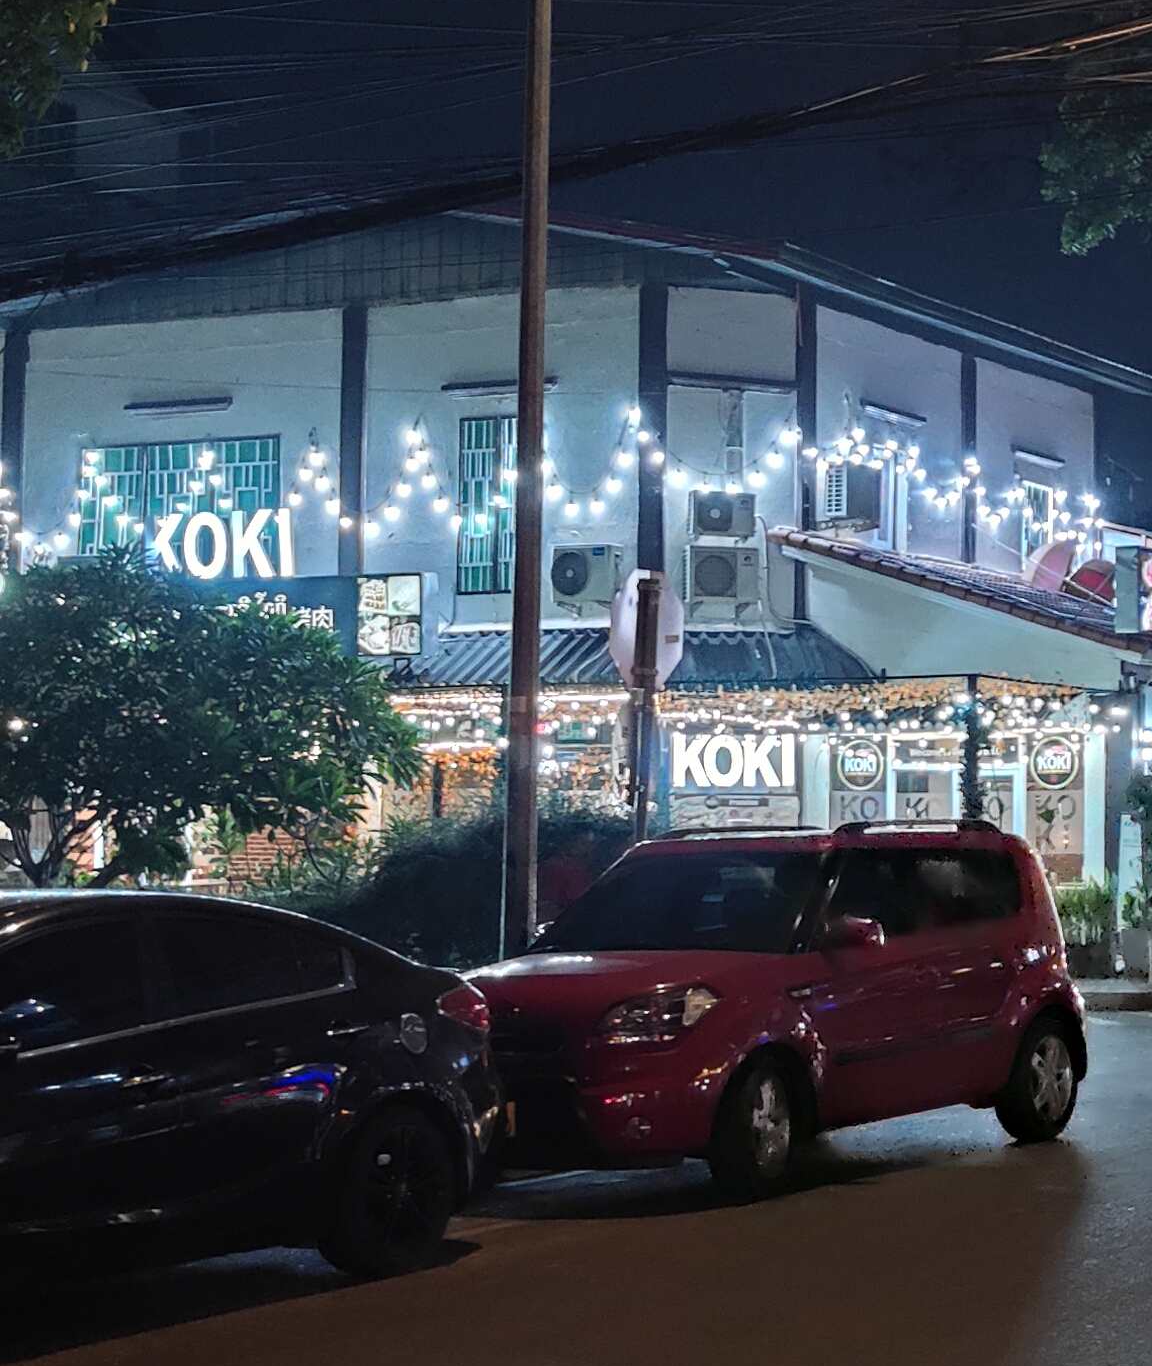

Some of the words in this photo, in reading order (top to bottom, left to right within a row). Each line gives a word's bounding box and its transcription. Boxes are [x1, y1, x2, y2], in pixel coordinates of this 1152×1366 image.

[154, 508, 293, 579] KOKI
[673, 733, 795, 787] KOKI
[844, 757, 876, 772] KOKI
[1037, 752, 1071, 770] KOKI
[840, 795, 880, 820] KO
